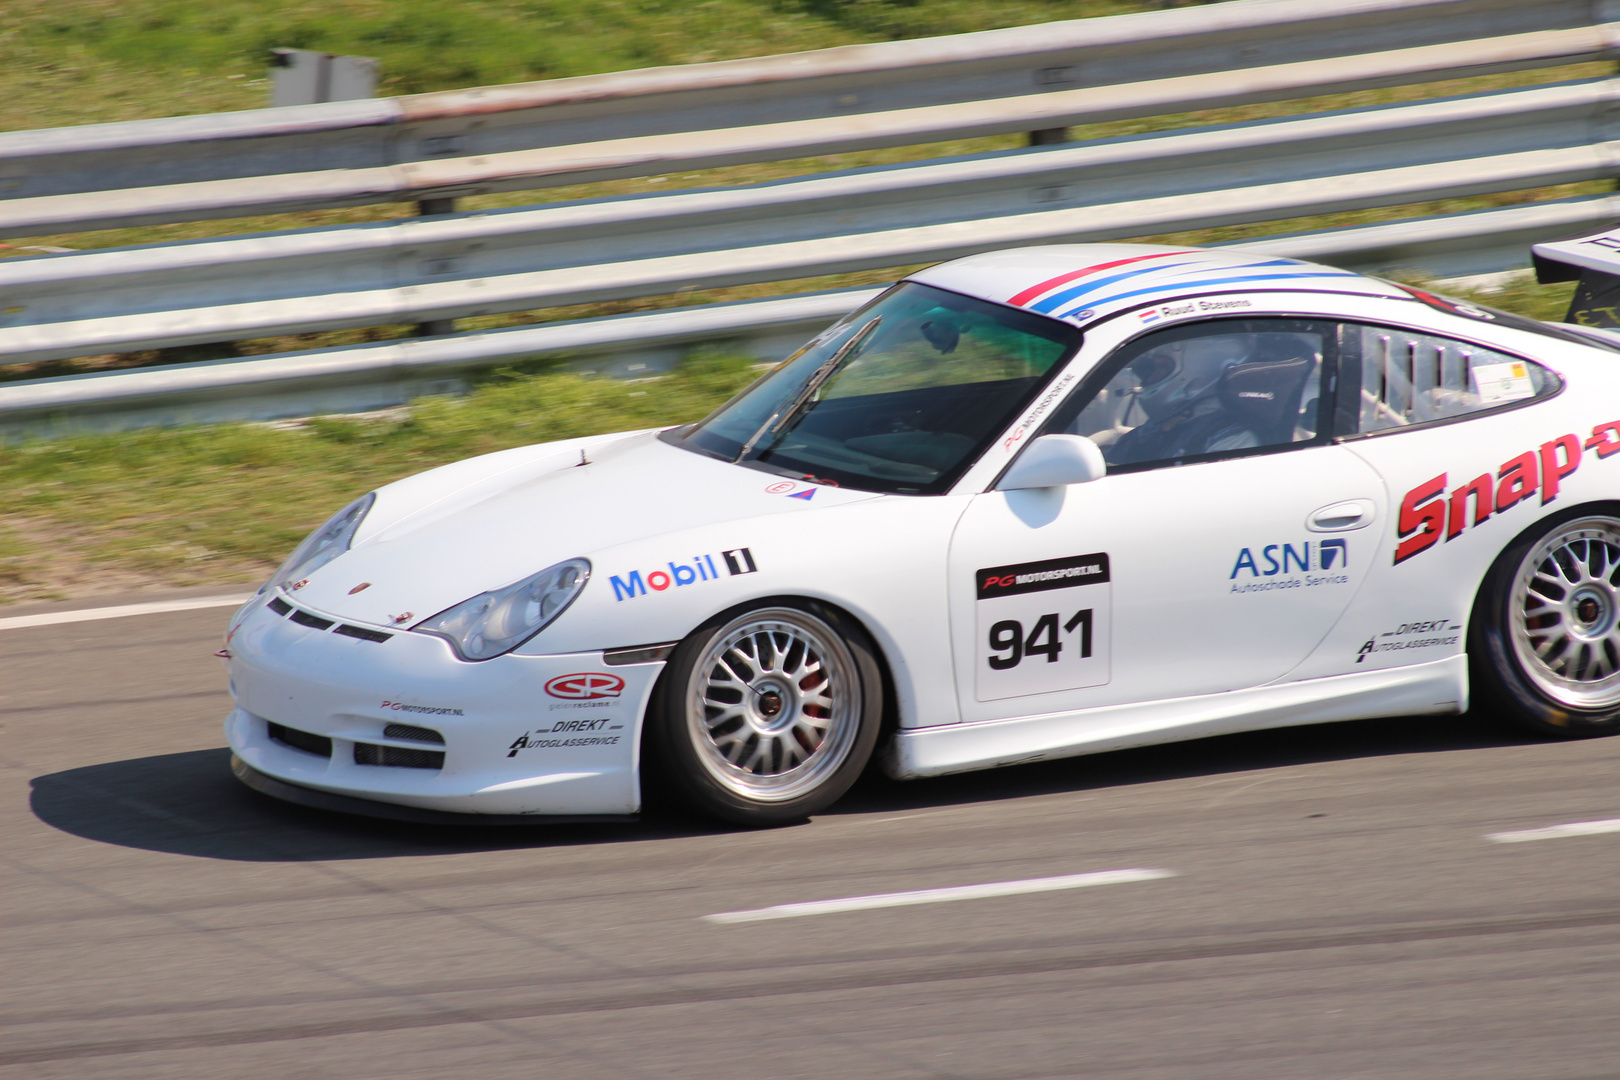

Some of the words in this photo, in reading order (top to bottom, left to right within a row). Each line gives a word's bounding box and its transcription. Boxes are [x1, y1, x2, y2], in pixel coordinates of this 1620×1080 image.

[1229, 541, 1310, 580] ASN
[608, 554, 719, 602] Mobil
[1229, 576, 1301, 594] Autoschade
[1304, 573, 1348, 587] Service
[988, 608, 1093, 671] 941
[1395, 619, 1450, 636] DIREKT
[551, 718, 610, 733] DIREKT
